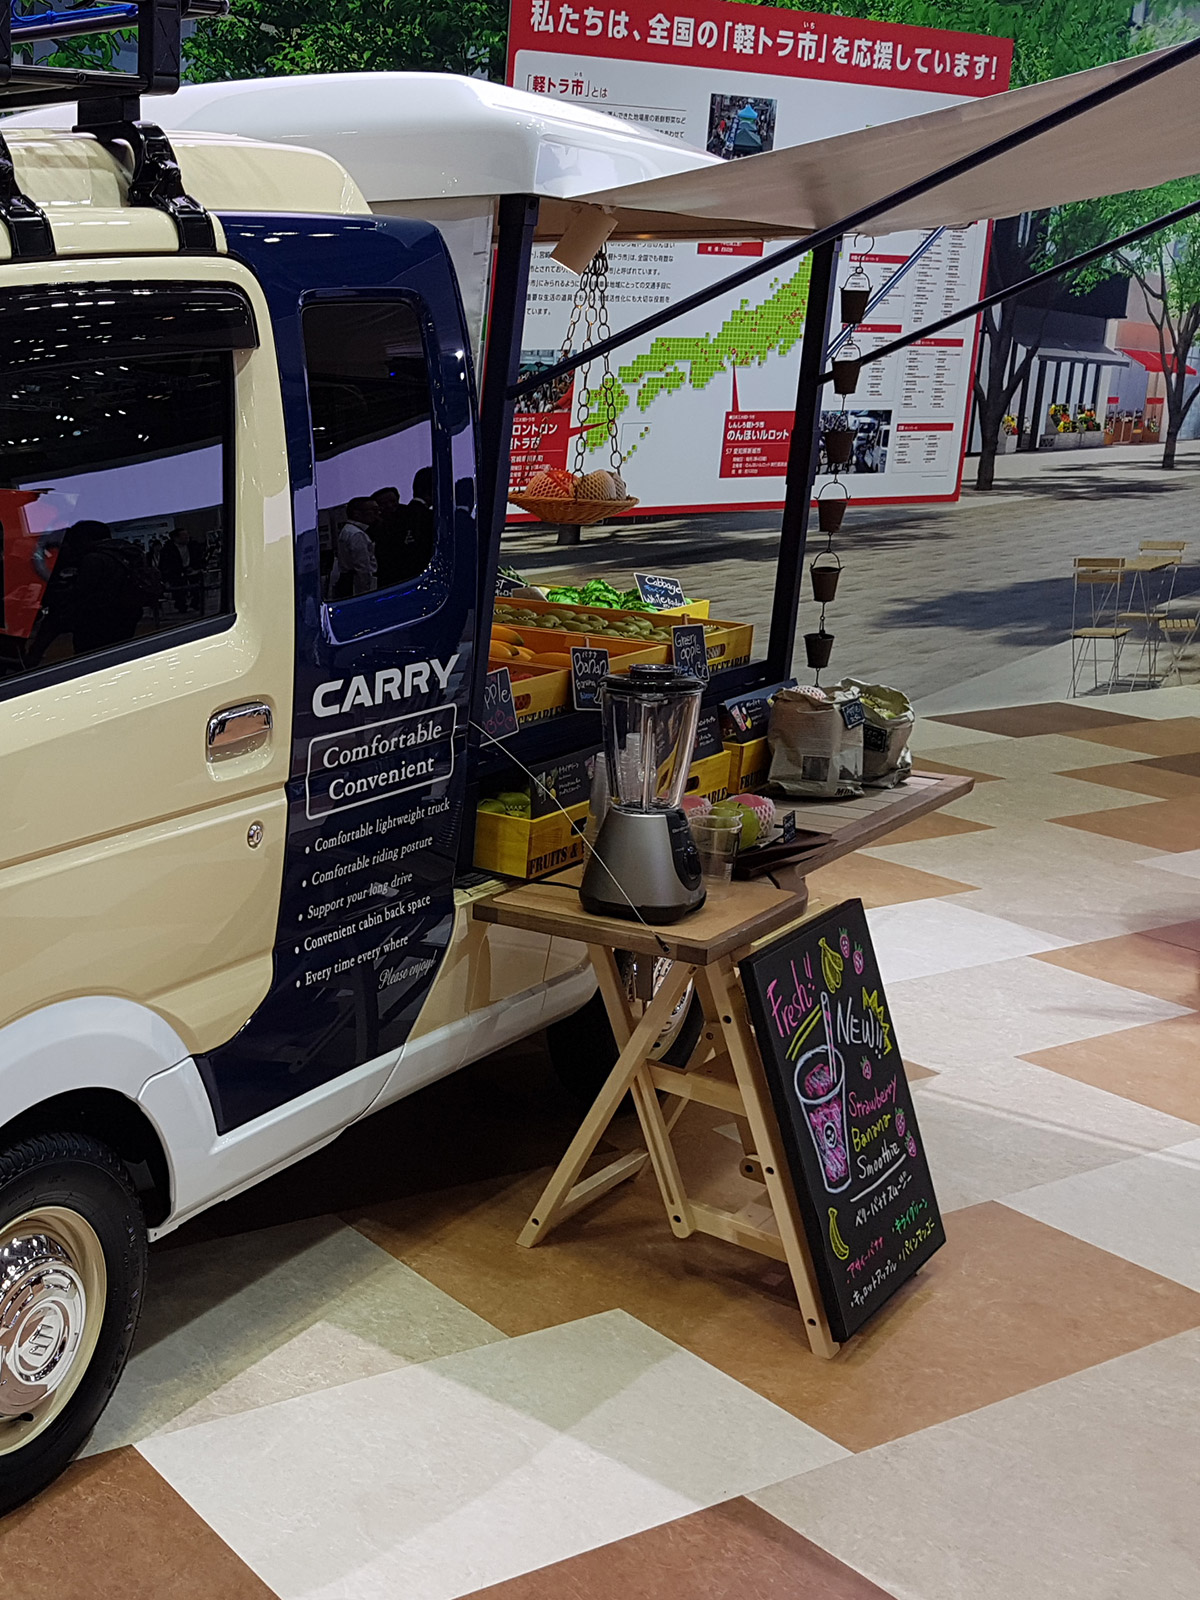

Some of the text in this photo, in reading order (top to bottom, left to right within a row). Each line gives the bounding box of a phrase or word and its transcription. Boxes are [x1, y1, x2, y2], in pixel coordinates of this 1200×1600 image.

[531, 0, 998, 82] 私たちは、全国の「軽トラ市」を応援しています!
[312, 653, 460, 718] CARRY
[322, 722, 442, 769] Comfortable
[329, 757, 434, 800] Convenient
[315, 798, 450, 851] Comfortable lightweight truck
[312, 835, 433, 885] Comfortable riding posture
[528, 841, 578, 876] FRUITS &
[307, 872, 413, 919] Support your long drive
[304, 894, 431, 951] Convenient cabin back space
[305, 934, 409, 986] Every time every where
[378, 949, 437, 989] Please enjoy!
[766, 951, 816, 1038] Fresh!!
[837, 996, 883, 1059] NEW!!
[848, 1074, 897, 1118] Strawberry
[851, 1114, 892, 1153] Banana
[857, 1139, 901, 1179] Smoothie
